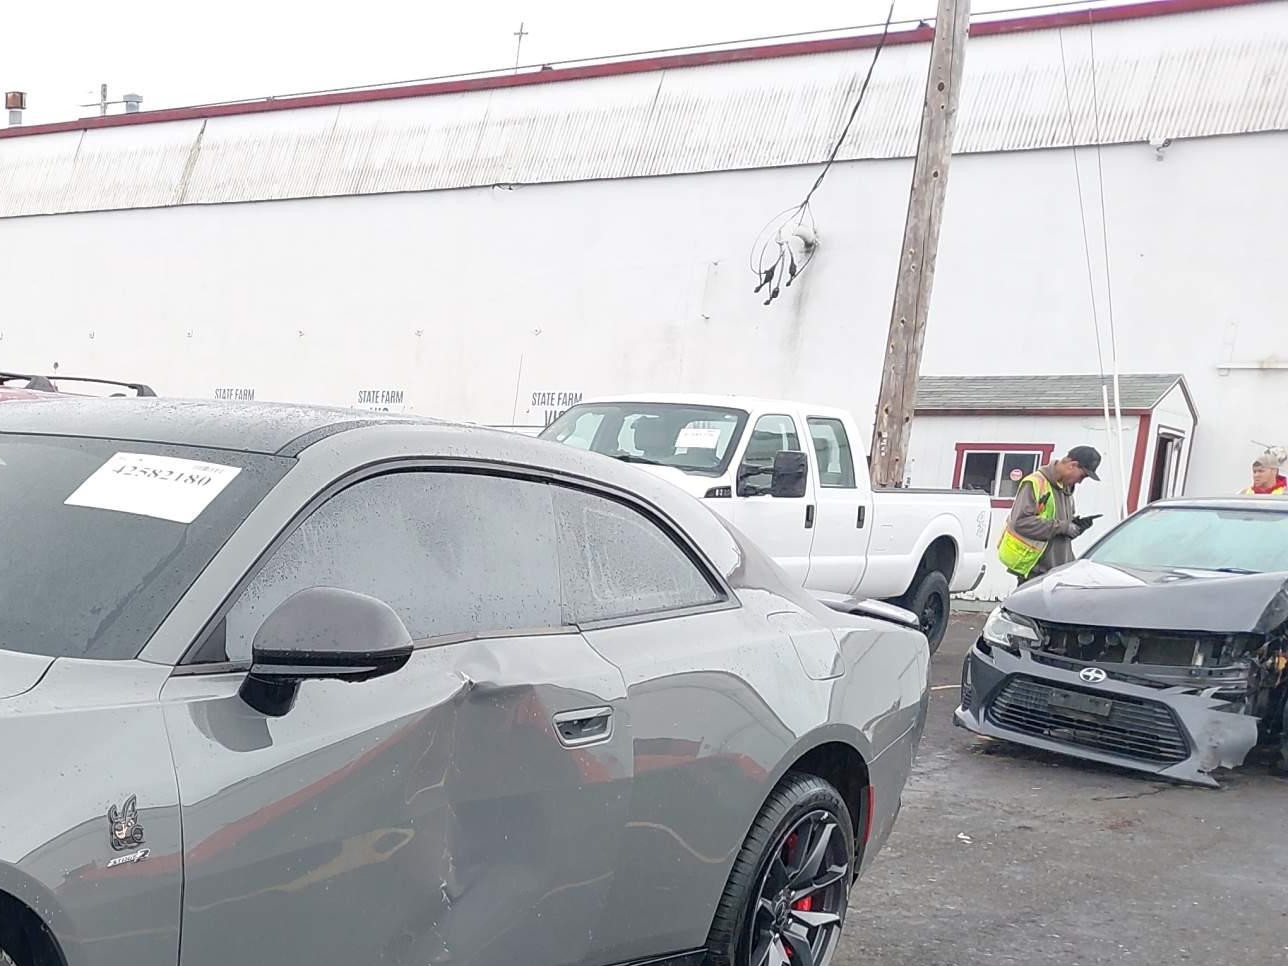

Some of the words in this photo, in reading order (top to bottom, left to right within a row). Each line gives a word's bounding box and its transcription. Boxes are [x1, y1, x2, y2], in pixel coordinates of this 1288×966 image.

[214, 388, 233, 400] STATE
[235, 388, 255, 400] FARM
[358, 390, 380, 404] STATE
[381, 390, 404, 404] FARM
[531, 392, 556, 406] STATE
[557, 392, 583, 406] FARM
[112, 464, 213, 487] 42582180
